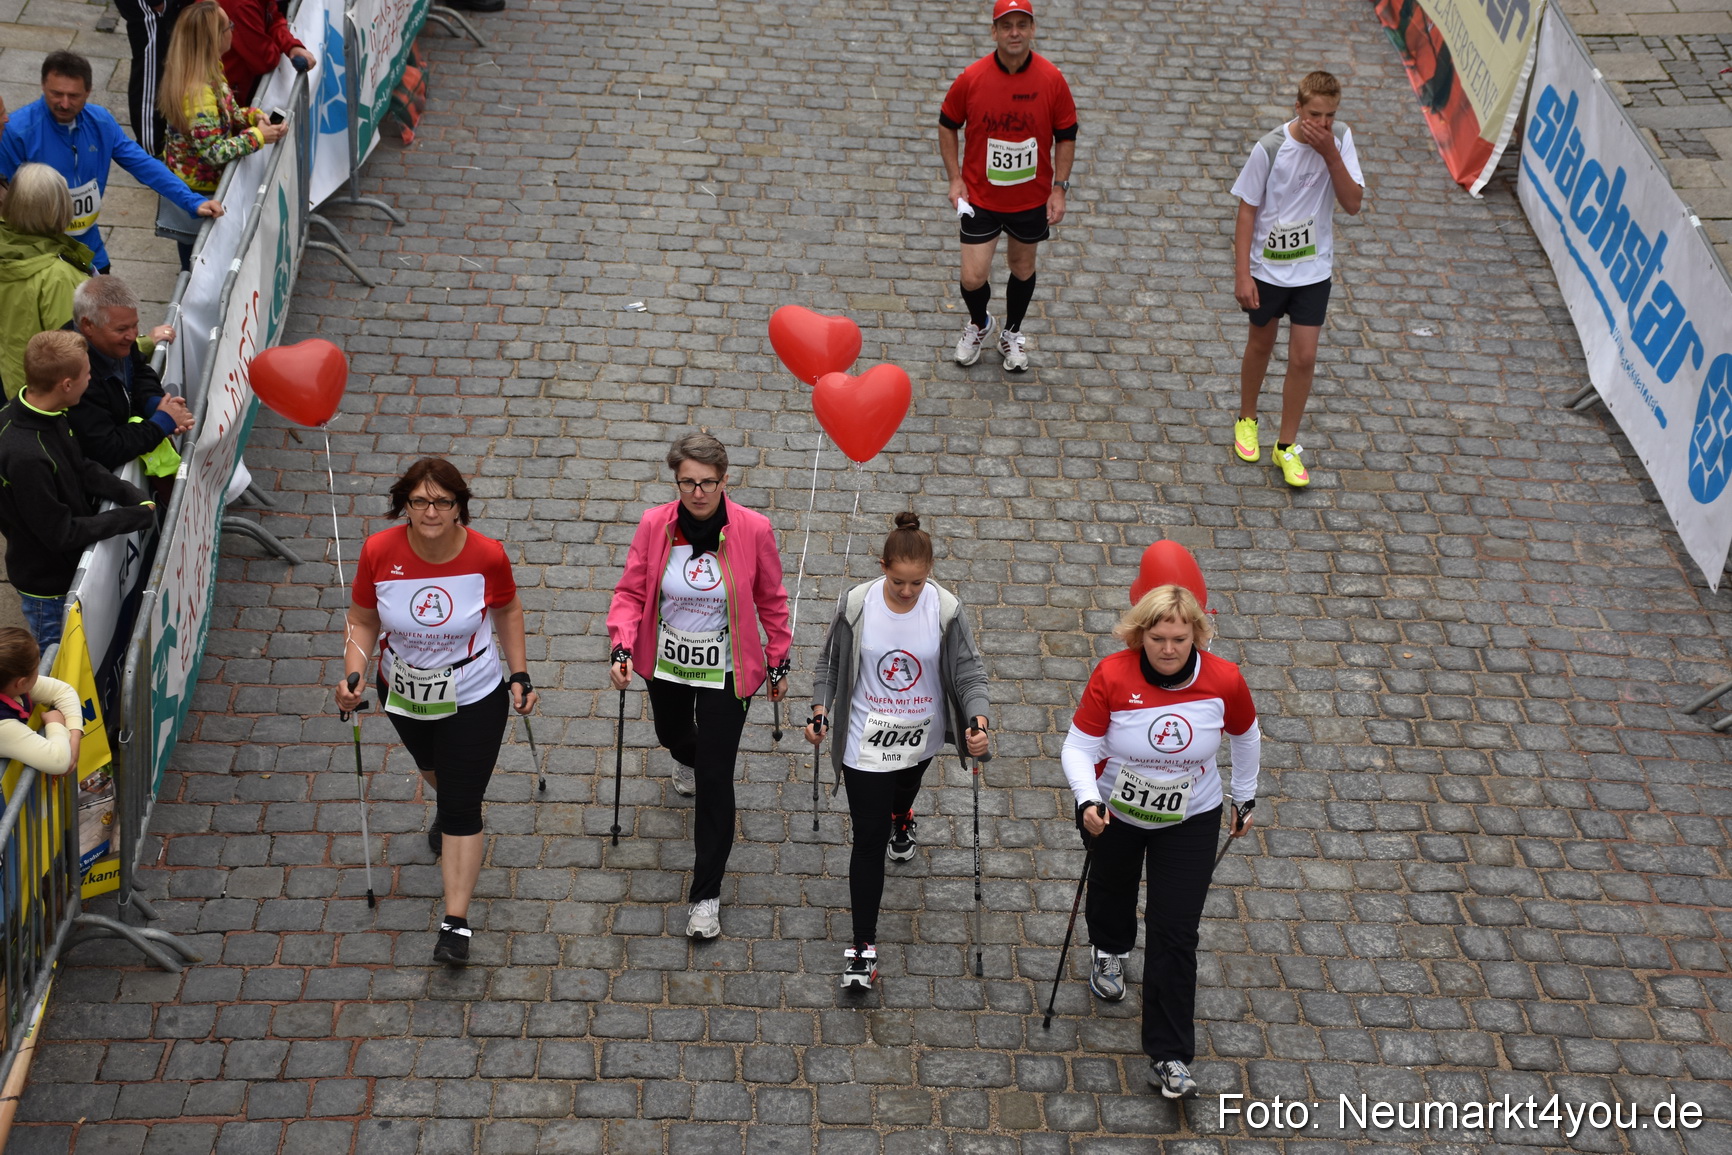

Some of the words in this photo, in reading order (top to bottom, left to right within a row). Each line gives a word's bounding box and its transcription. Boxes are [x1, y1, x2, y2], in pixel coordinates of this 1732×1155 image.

[992, 150, 1032, 170] 5311
[1268, 229, 1309, 249] 5131
[1527, 84, 1704, 385] slackstar
[1270, 250, 1307, 259] Alexander
[662, 627, 681, 641] PARTL
[681, 636, 714, 644] Neumarkt
[664, 638, 719, 666] 5050
[393, 661, 407, 675] PARTL
[407, 672, 442, 682] Neumarkt
[673, 667, 706, 679] Carmen
[395, 673, 448, 701] 5177
[412, 704, 427, 714] Elli
[868, 717, 892, 729] PARTL
[892, 722, 923, 730] Neumarkt
[868, 729, 923, 747] 4048
[882, 752, 901, 761] Anna
[1120, 769, 1144, 786] PARTL
[1144, 782, 1180, 791] Neumarkt
[1121, 781, 1182, 811] 5140
[1129, 808, 1162, 822] Kerstin
